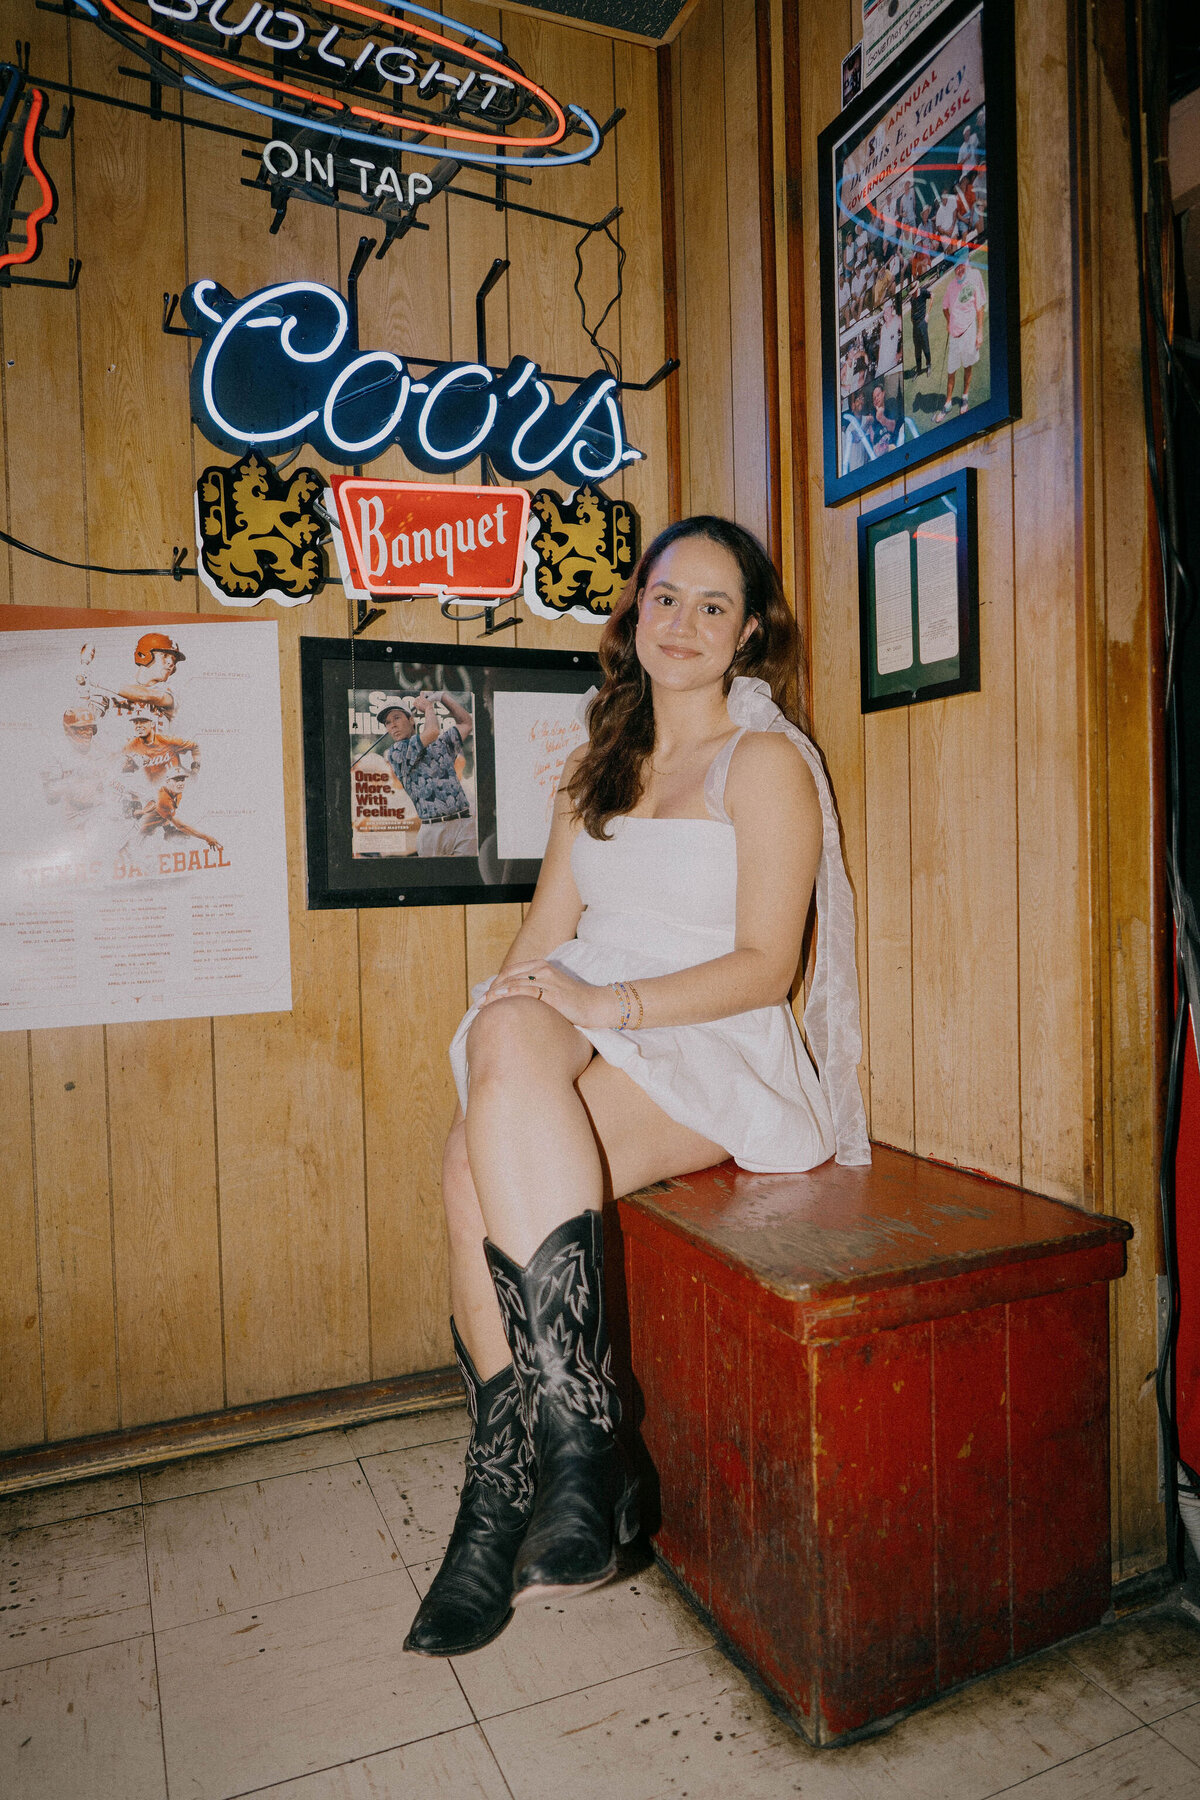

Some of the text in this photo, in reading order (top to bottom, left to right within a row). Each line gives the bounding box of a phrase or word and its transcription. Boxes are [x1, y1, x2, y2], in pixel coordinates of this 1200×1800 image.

[317, 26, 515, 109] LIGHT
[914, 65, 966, 127] Yancy
[887, 70, 938, 131] ANNUAL
[899, 138, 920, 164] CUP
[922, 88, 971, 142] CLASSIC
[263, 140, 433, 206] ON TAP
[357, 494, 508, 578] Banquet
[354, 770, 390, 782] Once
[355, 782, 395, 795] More,
[356, 794, 388, 806] With
[356, 805, 406, 820] Feeling
[112, 846, 231, 880] BAEBALL
